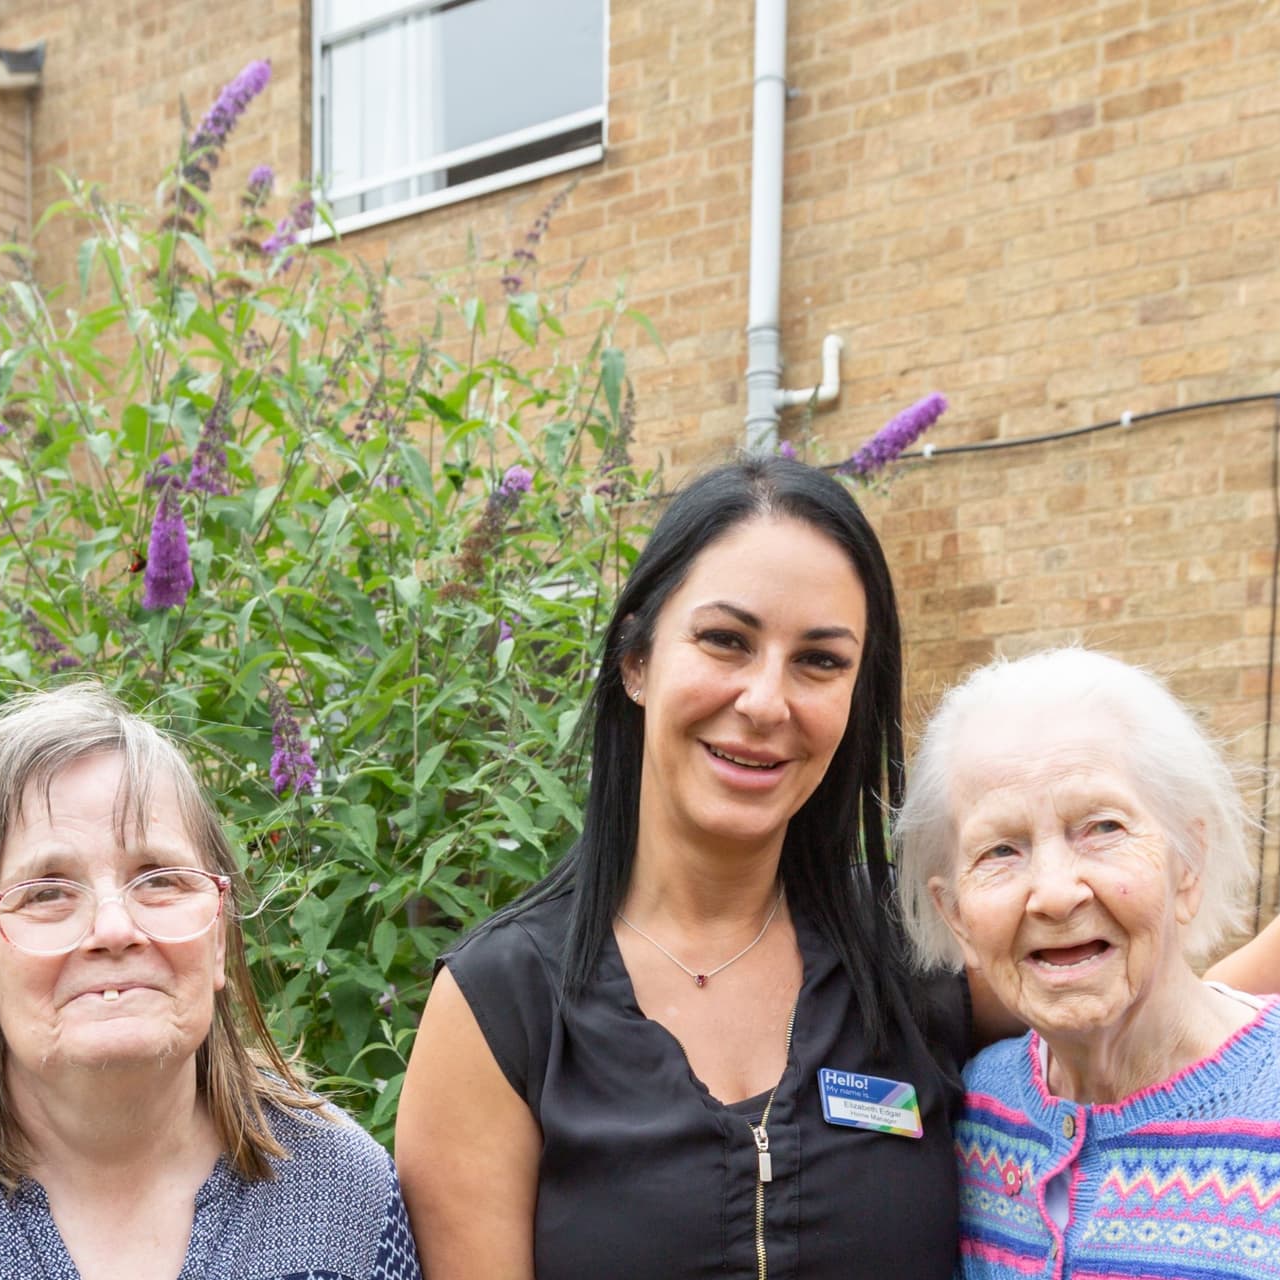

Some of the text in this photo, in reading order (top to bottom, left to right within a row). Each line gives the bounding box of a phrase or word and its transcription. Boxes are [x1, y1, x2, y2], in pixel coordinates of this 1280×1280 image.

[825, 1071, 869, 1090] Hello!
[826, 1085, 839, 1095] My
[840, 1088, 862, 1097] name
